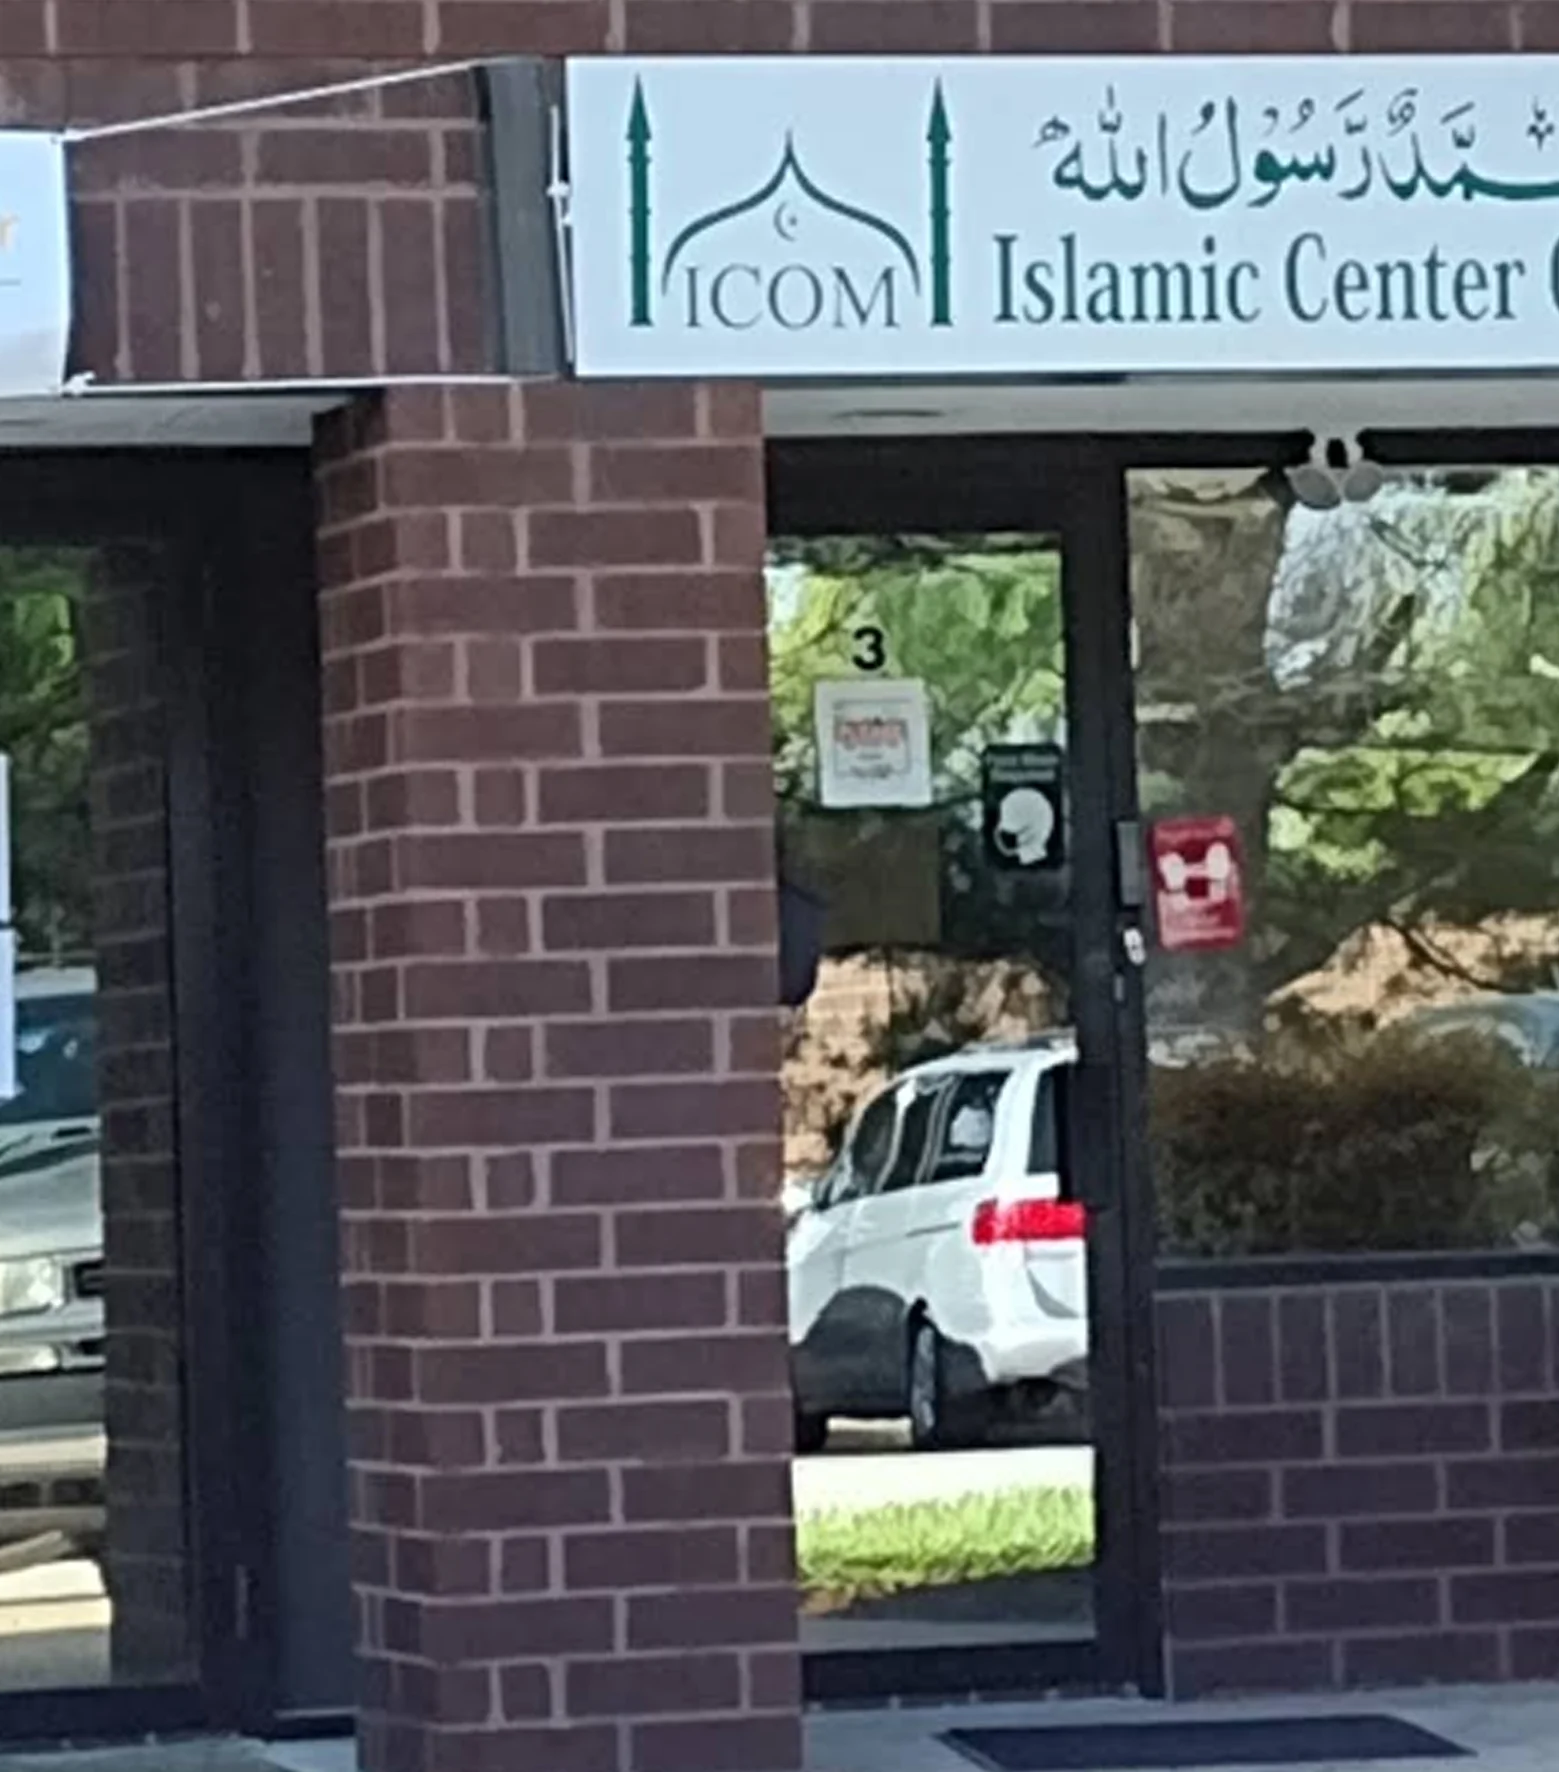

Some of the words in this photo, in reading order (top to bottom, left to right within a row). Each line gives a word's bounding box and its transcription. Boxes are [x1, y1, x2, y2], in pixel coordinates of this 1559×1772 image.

[684, 264, 901, 329] ICOM
[992, 232, 1262, 325] Islamic
[1283, 232, 1527, 324] Center
[852, 626, 887, 671] 3
